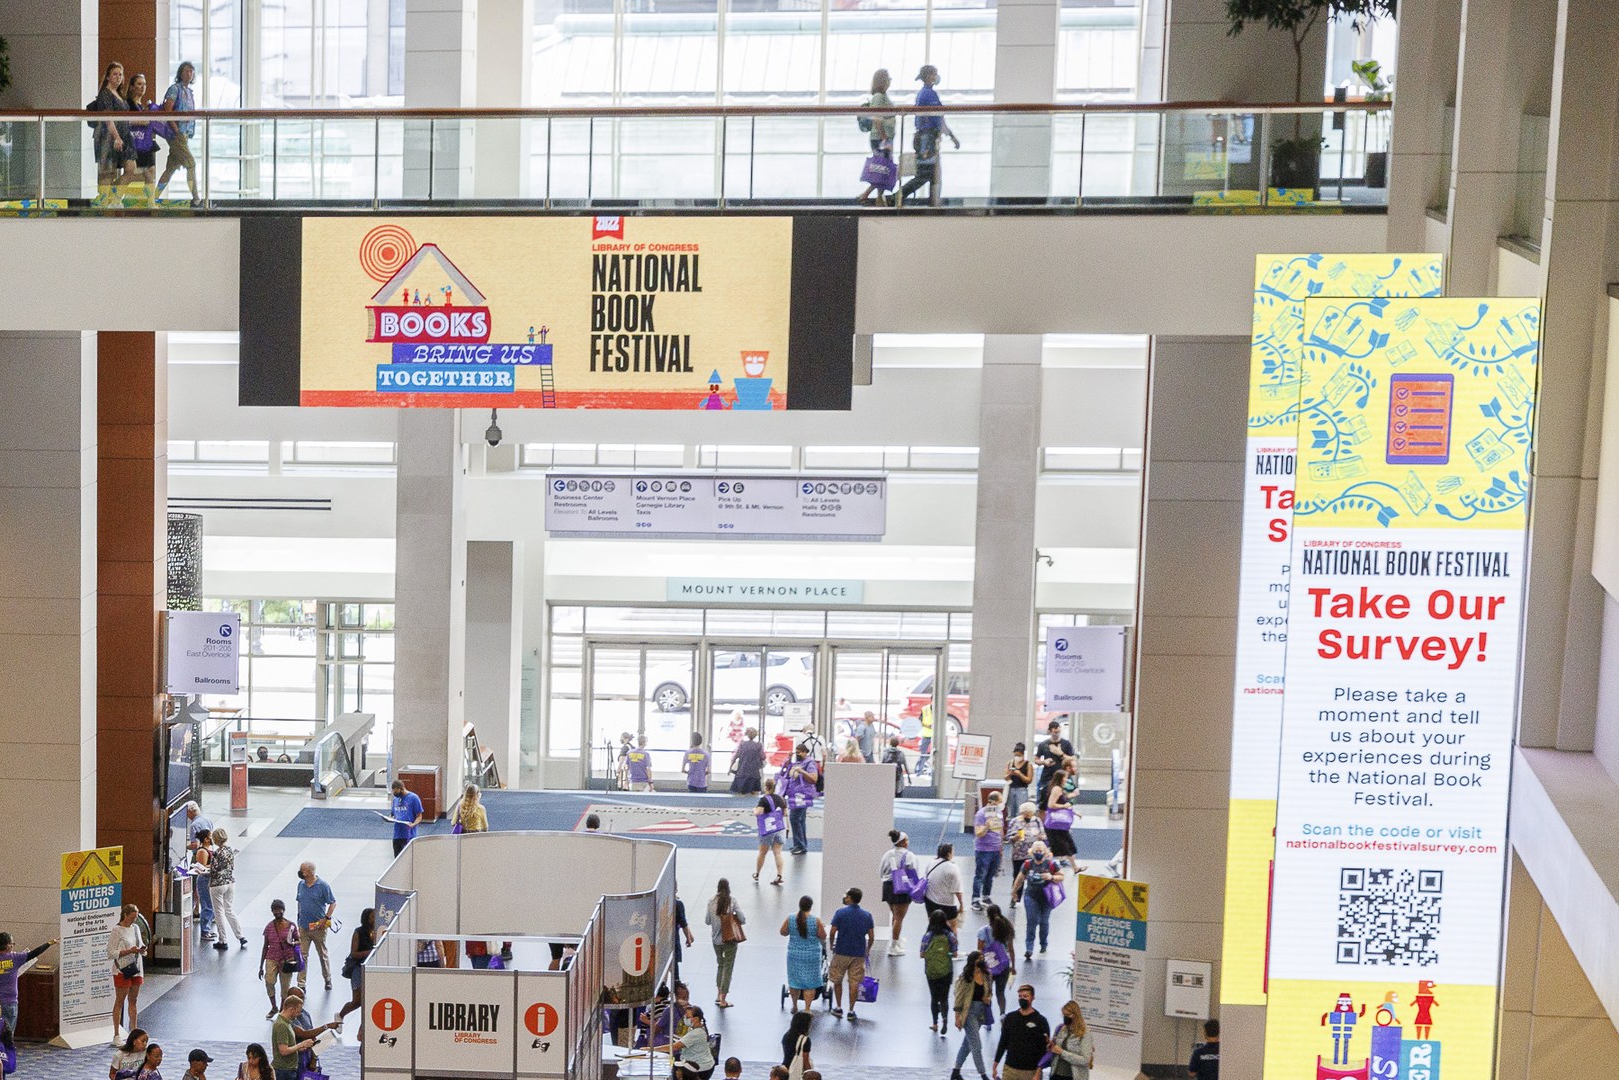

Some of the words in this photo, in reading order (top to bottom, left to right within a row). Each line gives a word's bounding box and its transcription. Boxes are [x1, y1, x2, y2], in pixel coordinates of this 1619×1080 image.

[592, 243, 631, 251] LIBRARY
[648, 244, 700, 252] CONGRESS
[592, 254, 702, 293] NATIONAL
[591, 295, 655, 332] BOOK
[380, 312, 489, 338] BOOKS
[412, 344, 494, 364] BRING
[501, 345, 537, 364] US
[589, 334, 694, 373] FESTIVAL
[378, 370, 513, 388] TOGETHER
[1304, 540, 1340, 548] LIBRARY
[1355, 541, 1402, 549] CONGRESS
[1303, 549, 1380, 575] NATIONAL
[1386, 551, 1431, 577] BOOK
[1436, 552, 1510, 577] FESTIVAL
[682, 585, 734, 594] MOUNT
[741, 586, 798, 596] VERNON
[805, 587, 847, 597] PLACE
[1308, 586, 1410, 619] Take
[1428, 589, 1506, 620] Our
[206, 637, 232, 645] Rooms
[1317, 629, 1487, 670] Survey!
[194, 676, 231, 685] Ballrooms
[1334, 687, 1398, 702] Please
[1406, 688, 1448, 703] take
[1455, 692, 1466, 703] a
[1318, 709, 1399, 723] moment
[1406, 710, 1442, 724] and
[1450, 710, 1479, 724] tell
[1331, 731, 1352, 743] us
[1359, 730, 1415, 744] about
[1422, 733, 1465, 747] your
[1303, 749, 1422, 764] experiences
[1430, 751, 1491, 770] during
[1309, 770, 1340, 783] the
[1347, 771, 1426, 786] National
[1434, 773, 1482, 787] Book
[1354, 792, 1433, 807] Festival.
[1302, 823, 1342, 836] Scan
[1348, 824, 1374, 837] the
[1380, 825, 1421, 838] code
[1426, 827, 1443, 838] or
[1448, 826, 1483, 839] visit
[1286, 840, 1497, 855] nationalbookfestivalsurvey.com
[68, 885, 115, 901] WRITERS
[72, 897, 110, 912] STUDIO
[1091, 916, 1131, 929] SCIENCE
[1087, 924, 1124, 938] FICTION
[1126, 931, 1134, 939] &
[1089, 933, 1132, 947] FANTASY
[429, 1002, 500, 1033] LIBRARY
